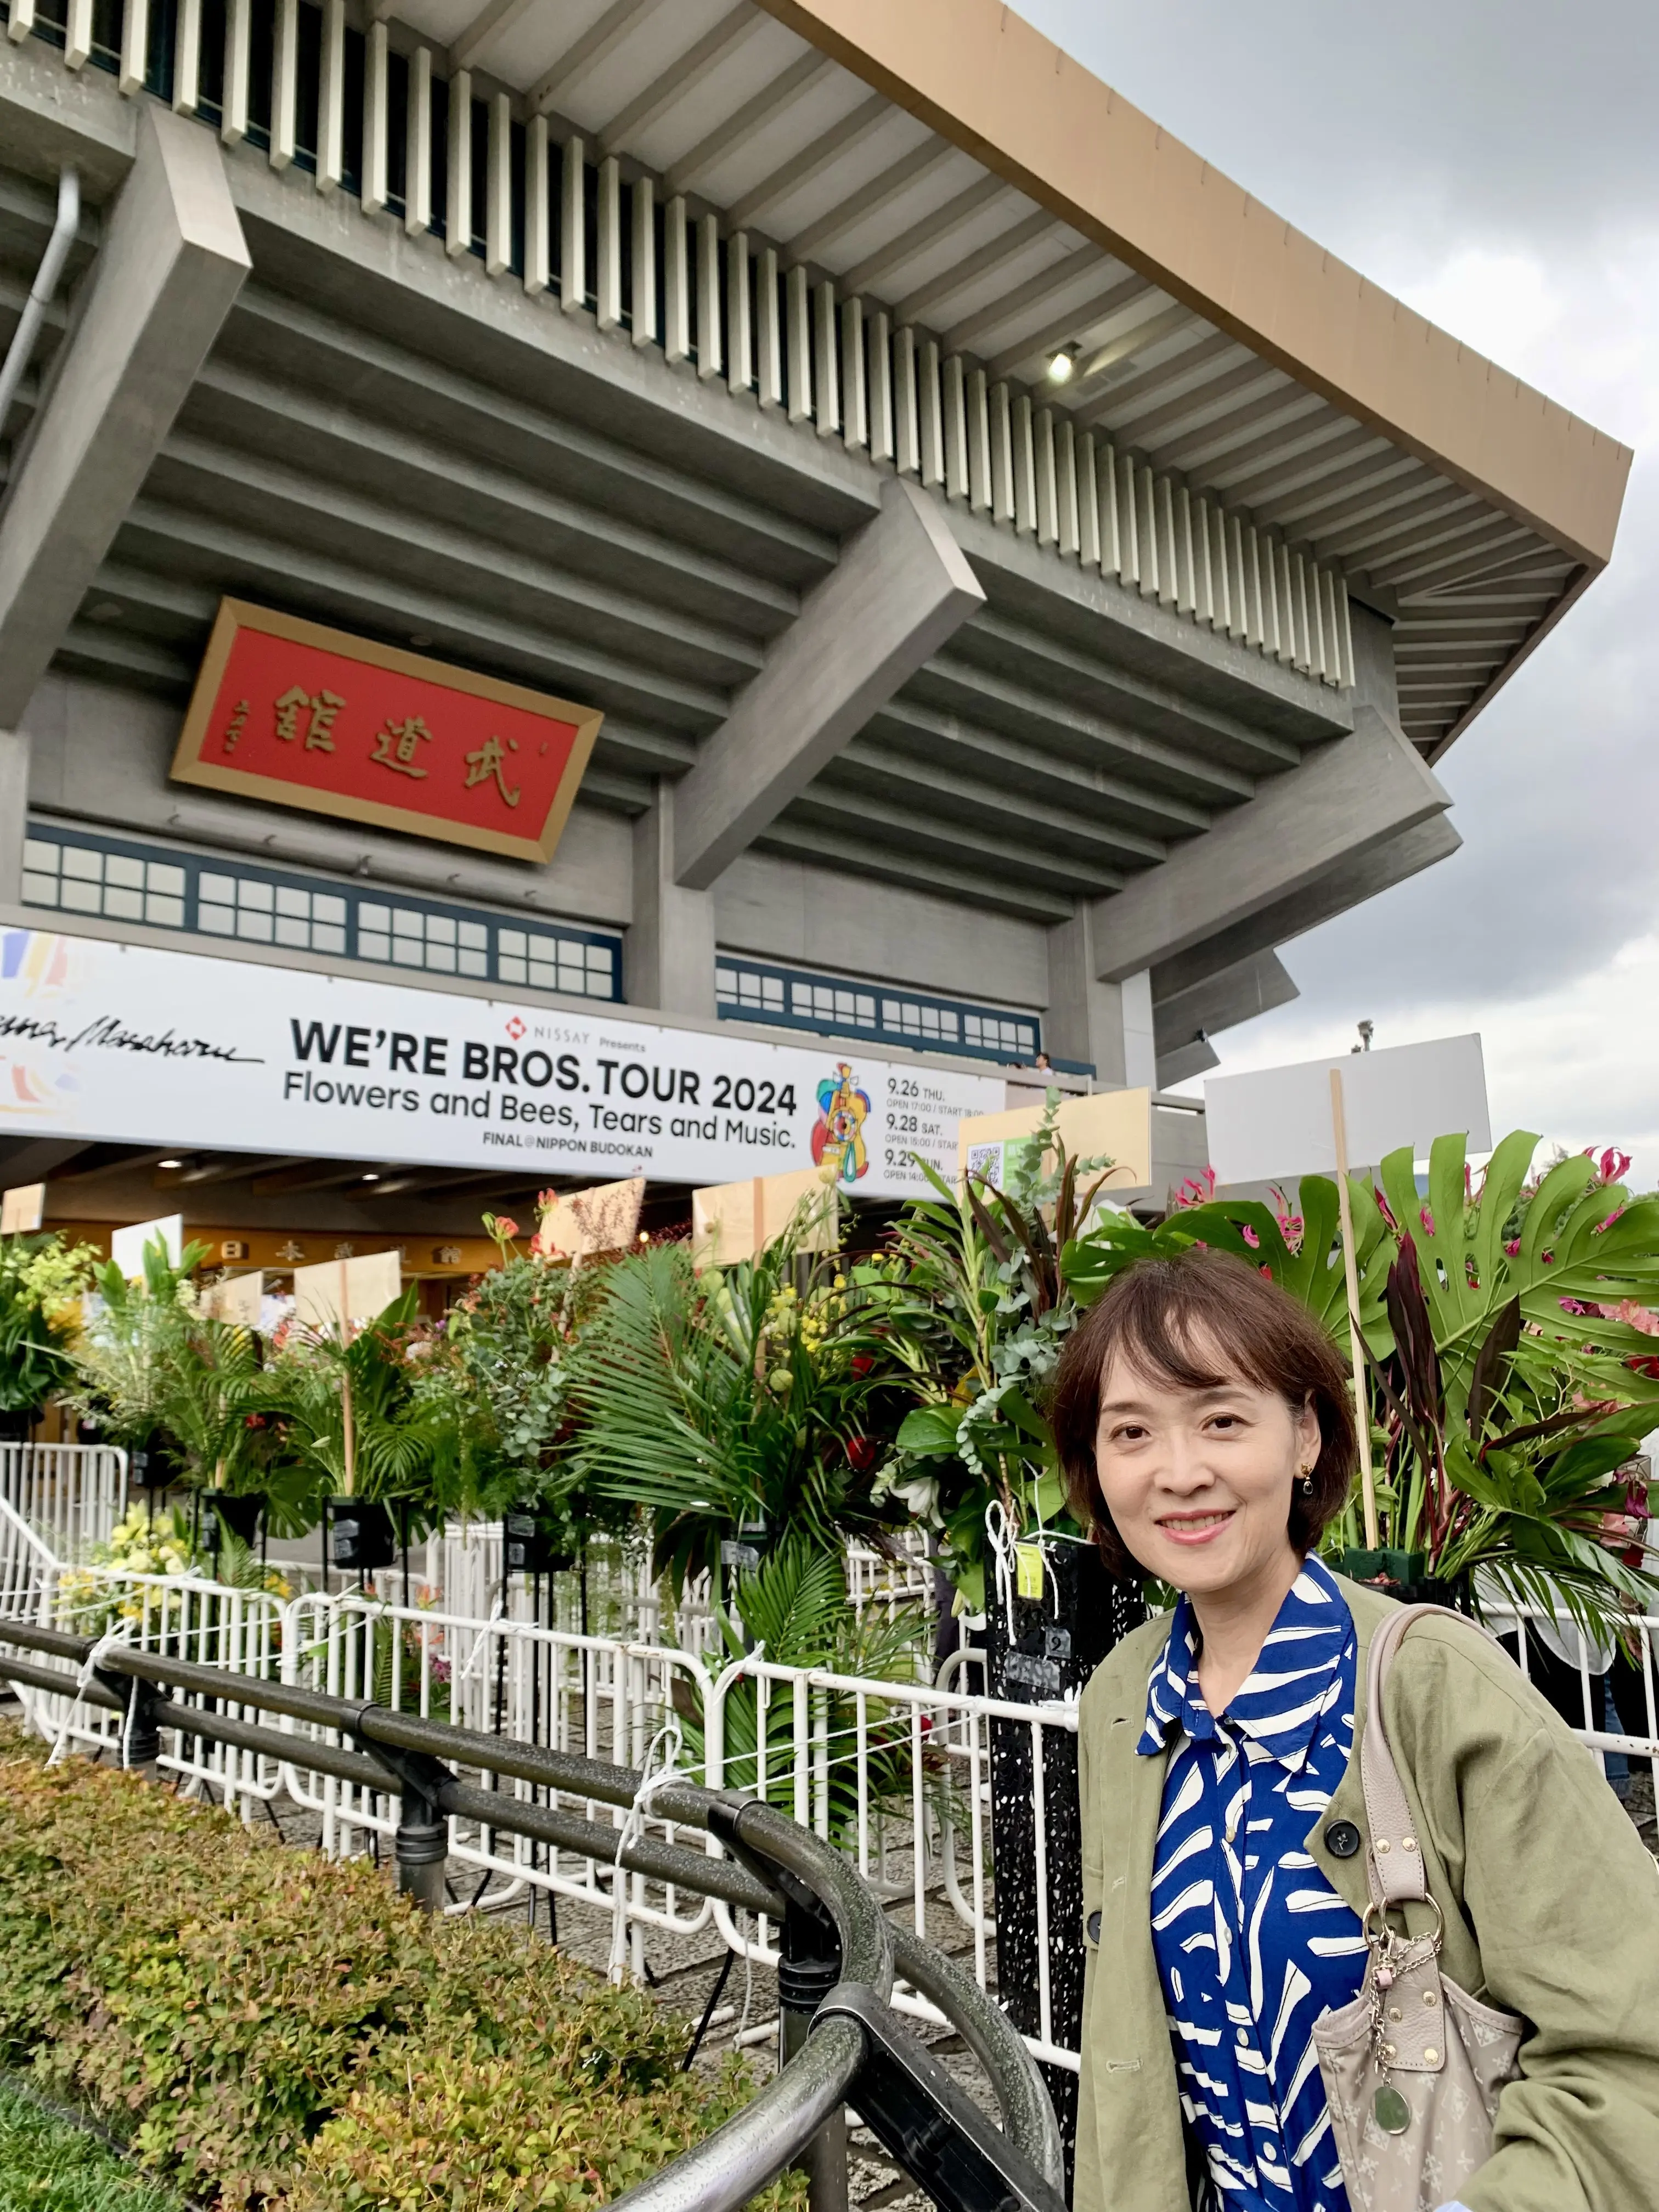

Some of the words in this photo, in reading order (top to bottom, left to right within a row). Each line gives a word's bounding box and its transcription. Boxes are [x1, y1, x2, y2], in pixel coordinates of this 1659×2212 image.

[535, 1027, 589, 1043] NISSAY
[600, 1037, 646, 1053] Presents
[713, 1075, 796, 1116] 2024
[888, 1077, 919, 1097] 9.26
[923, 1088, 945, 1102] THU.
[284, 1071, 419, 1111] Flowers
[430, 1091, 490, 1118] and
[500, 1095, 579, 1132] Bees,
[589, 1104, 662, 1135] Tears
[670, 1116, 717, 1139] and
[725, 1119, 794, 1148] Music.
[887, 1098, 909, 1109] OPEN
[911, 1102, 931, 1112] 17:00
[939, 1105, 962, 1116] START
[887, 1113, 917, 1132] 9.28
[922, 1123, 942, 1136] SAT.
[885, 1133, 907, 1144] OPEN
[590, 1141, 654, 1158] BUDOKAN
[885, 1149, 916, 1167] 9.29
[884, 1169, 906, 1180] OPEN
